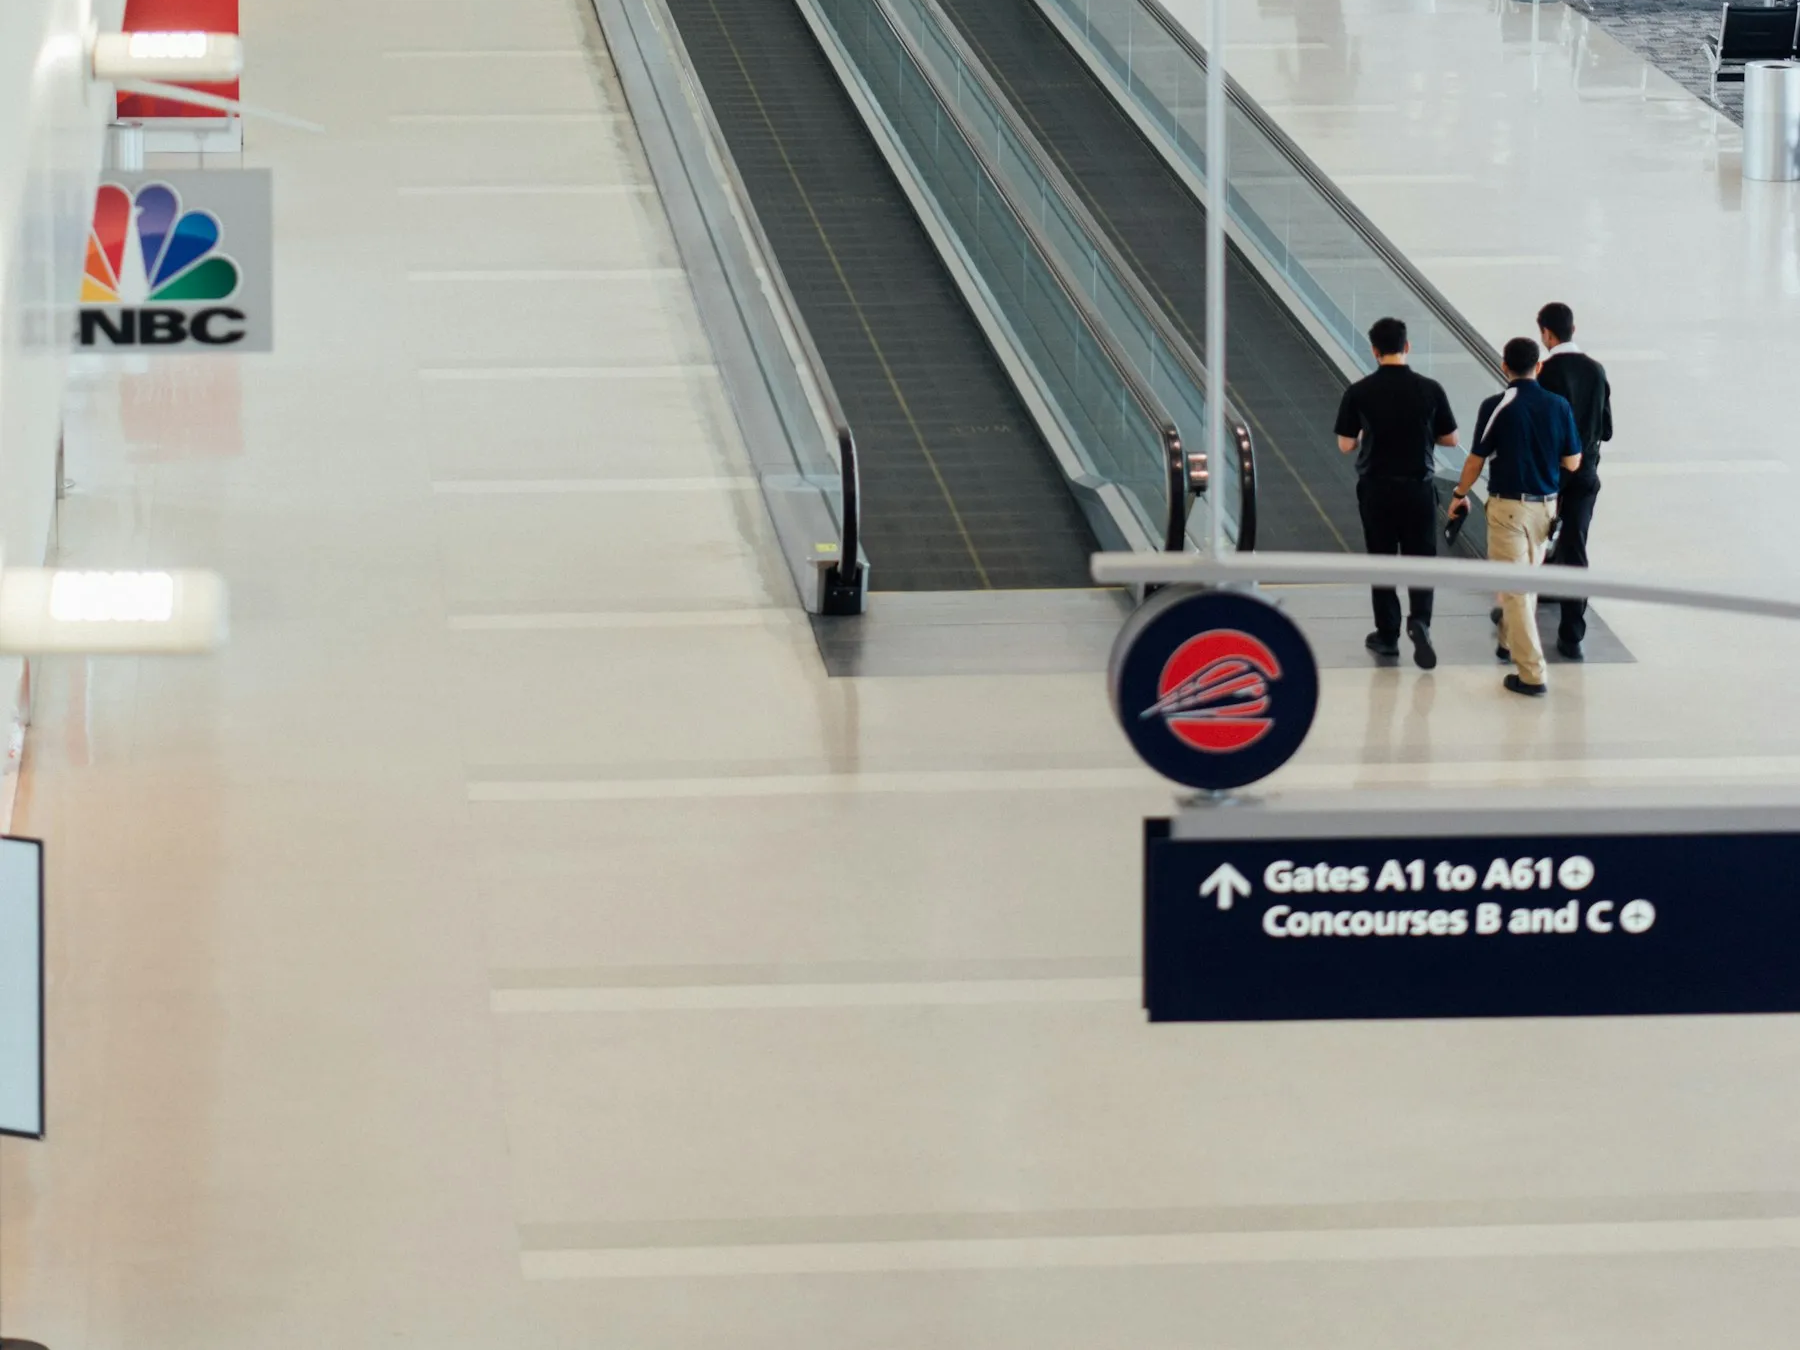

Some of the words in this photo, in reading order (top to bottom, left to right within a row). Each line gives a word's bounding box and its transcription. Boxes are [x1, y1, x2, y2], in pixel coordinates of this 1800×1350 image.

[79, 307, 246, 346] NBC
[1264, 860, 1369, 893] Gates
[1376, 859, 1425, 891] A1
[1435, 859, 1477, 891] to
[1482, 857, 1553, 890] A61
[1263, 904, 1468, 937] Concourses
[1475, 902, 1502, 934] B
[1508, 899, 1578, 934] and
[1586, 900, 1613, 933] C
